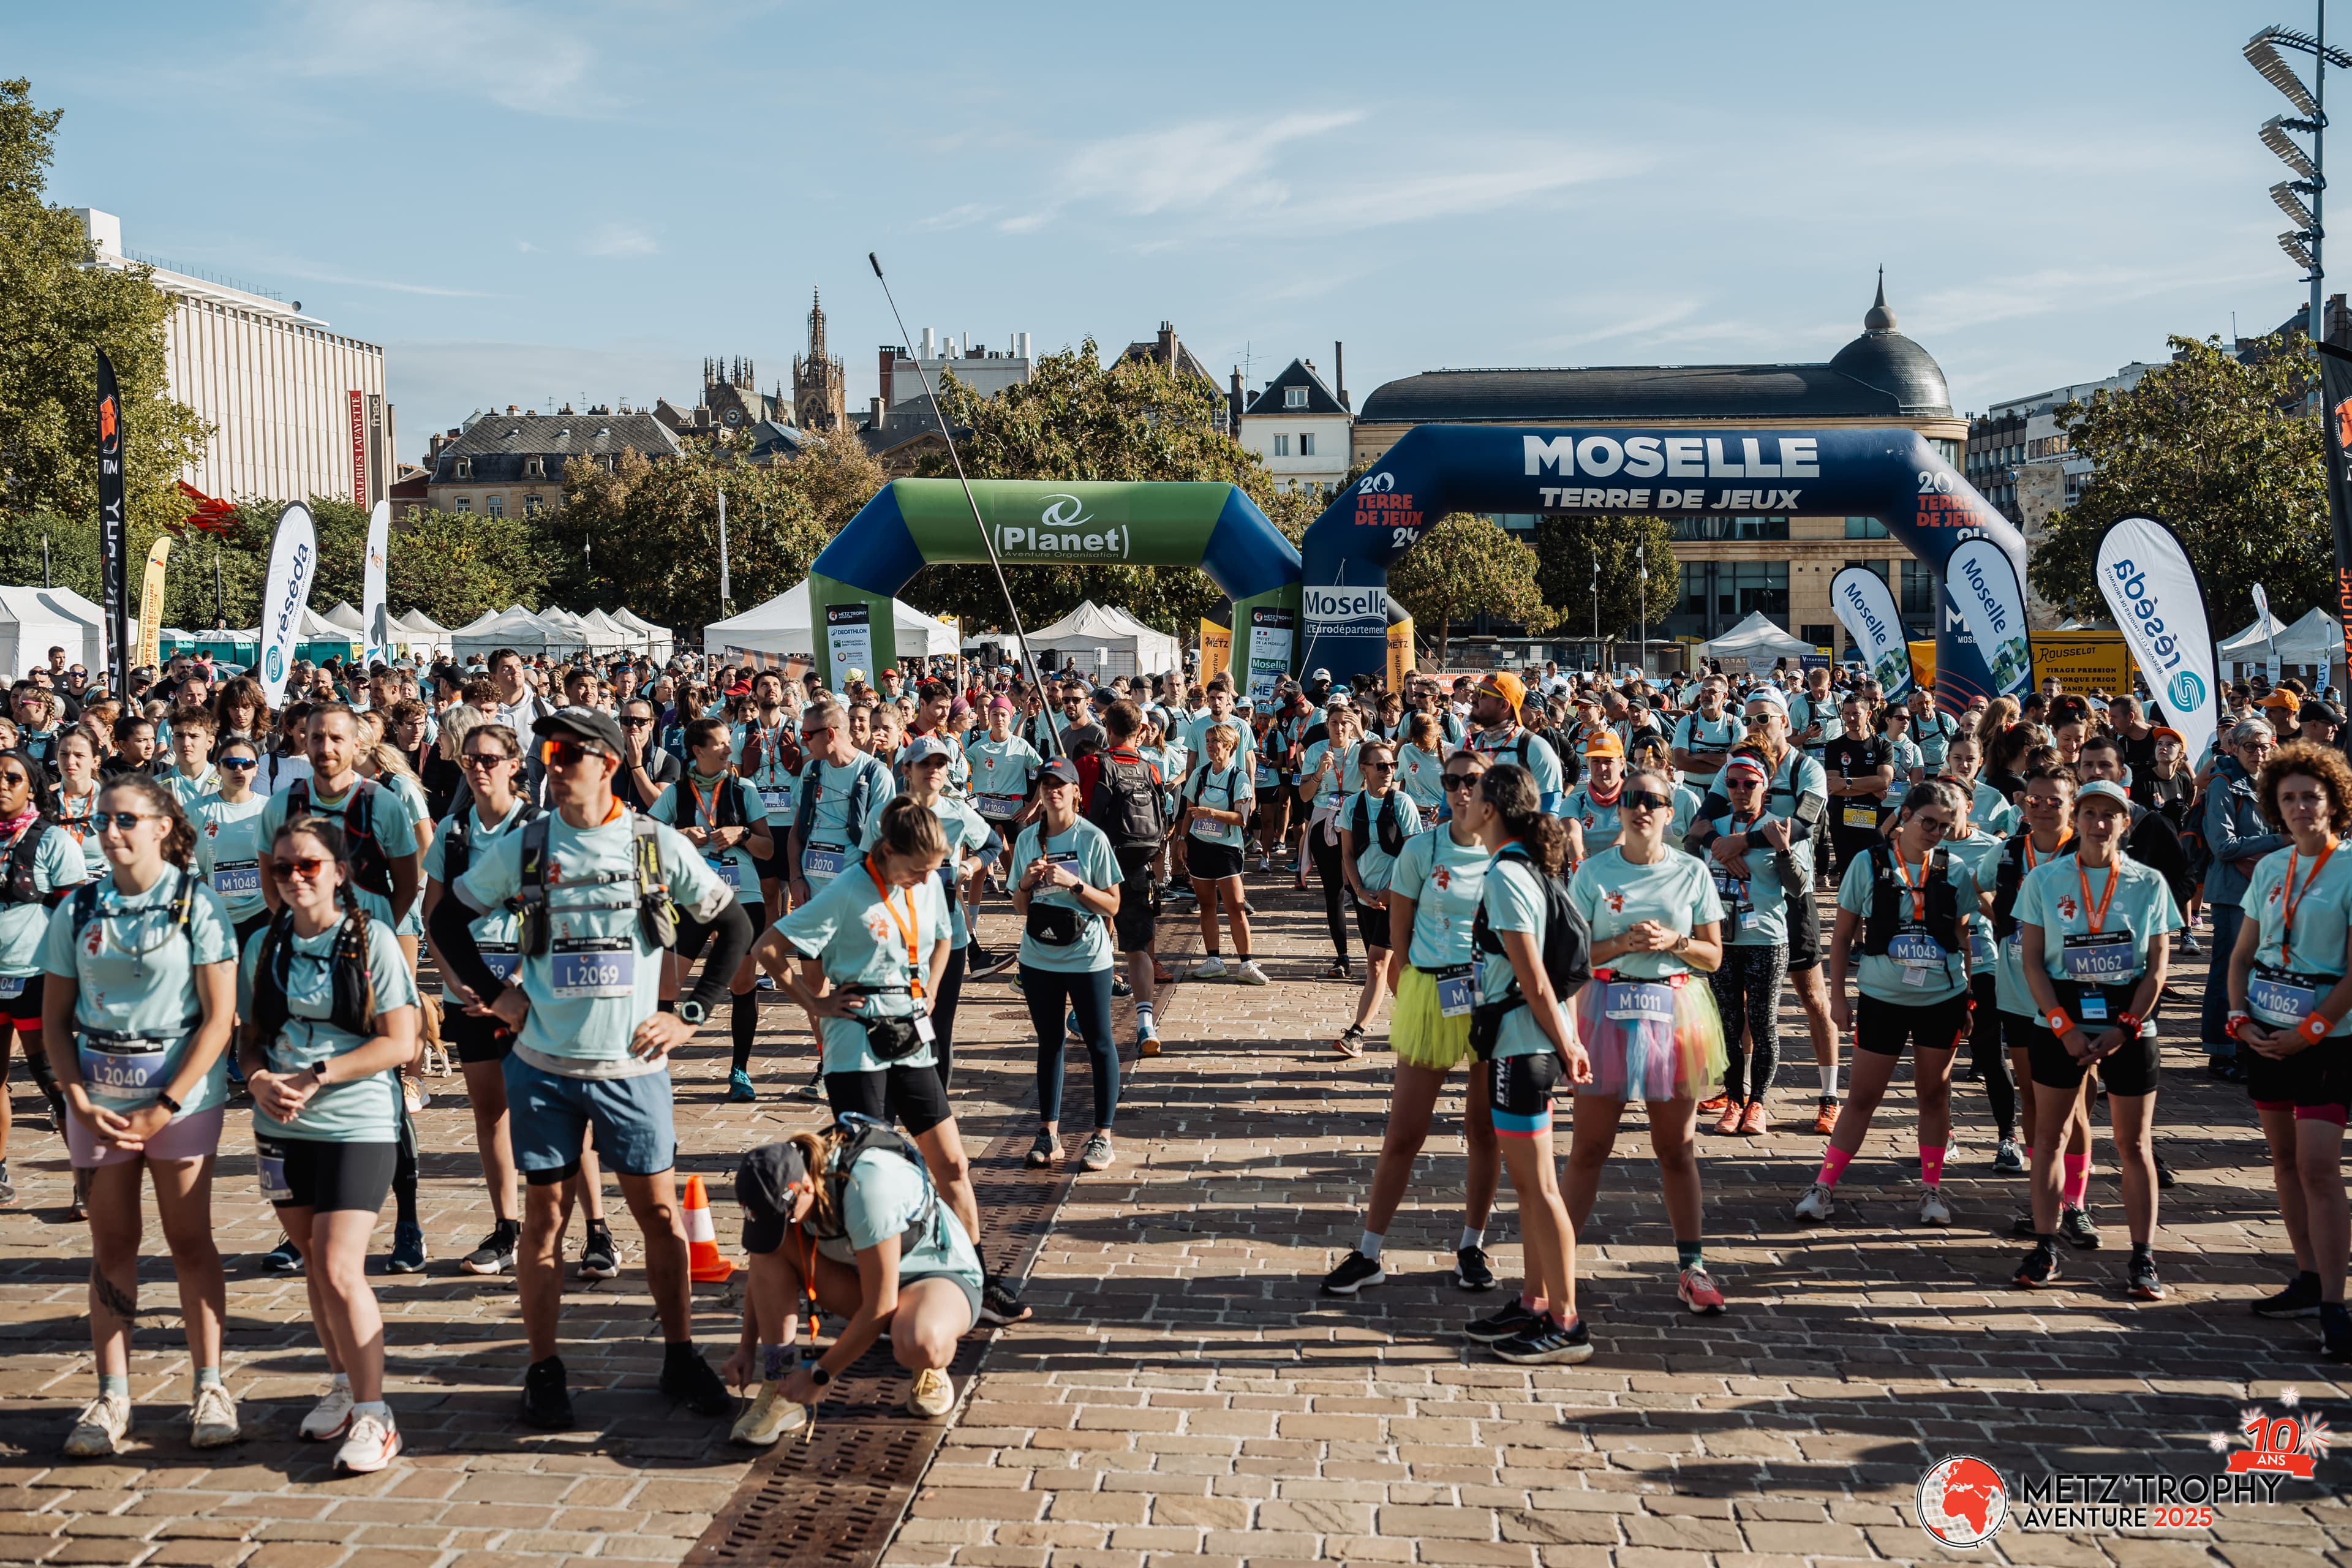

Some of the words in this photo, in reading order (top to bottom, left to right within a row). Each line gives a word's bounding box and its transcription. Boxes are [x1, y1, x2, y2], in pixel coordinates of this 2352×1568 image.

[371, 397, 380, 428] fnac
[352, 396, 363, 452] LAFAYETTE
[1523, 435, 1820, 478] MOSELLE
[353, 456, 365, 505] GALERIES
[1358, 472, 1395, 494] 20
[1918, 471, 1953, 493] 20
[1357, 494, 1412, 509] TERRE
[1539, 488, 1650, 508] TERRE
[1657, 489, 1705, 509] DE
[1710, 489, 1802, 509] JEUX
[1918, 495, 1973, 510] TERRE
[1355, 510, 1378, 526] DE
[1382, 511, 1423, 526] JEUX
[1917, 512, 1940, 527] DE
[1944, 512, 1987, 527] JEUX
[1392, 527, 1419, 548] 24
[277, 543, 309, 644] réséda
[1305, 590, 1386, 616] Moselle
[1961, 557, 2006, 635] Moselle
[1844, 582, 1887, 646] Moselle
[1307, 624, 1384, 635] L'Eurodépartement
[1206, 639, 1229, 648] METZ
[1387, 641, 1409, 649] METZ
[1252, 659, 1286, 670] Moselle
